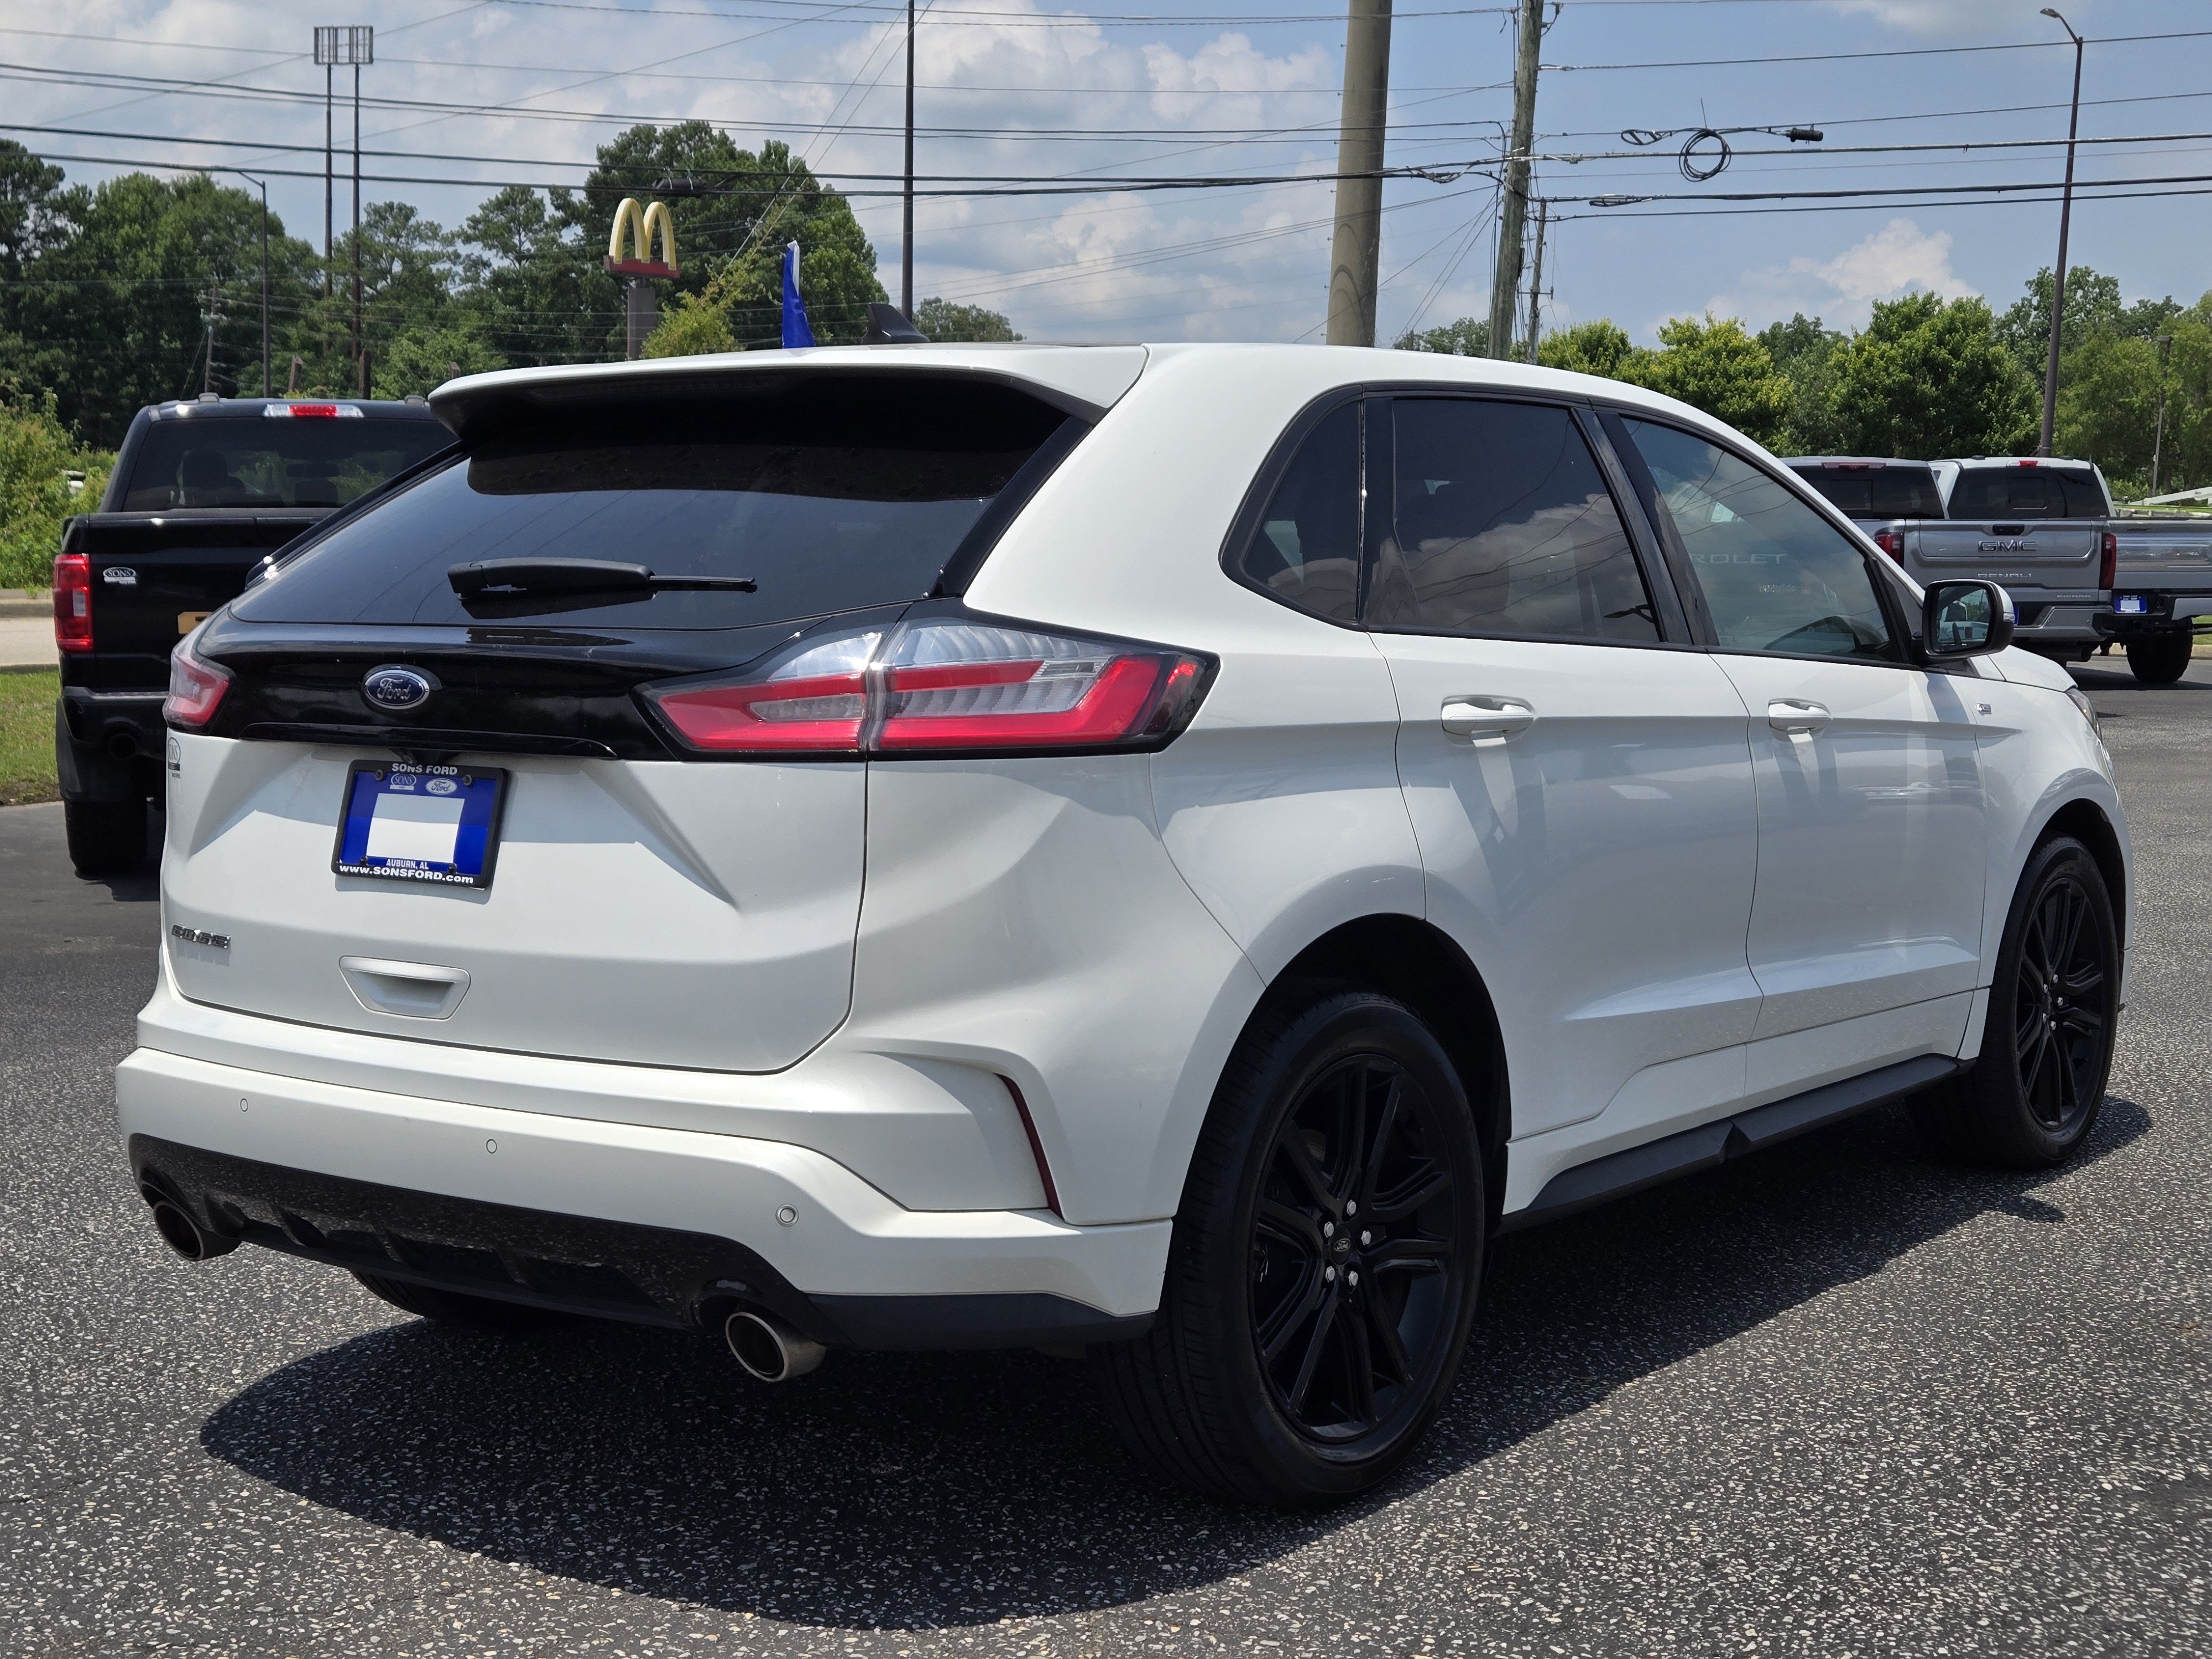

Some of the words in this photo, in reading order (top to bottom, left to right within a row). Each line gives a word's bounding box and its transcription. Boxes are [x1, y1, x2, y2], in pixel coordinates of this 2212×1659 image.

[1978, 539, 2037, 552] GMC
[377, 677, 411, 700] Ford
[392, 763, 422, 773] SONS
[426, 765, 458, 775] FORD
[394, 775, 413, 785] SONS
[431, 780, 451, 792] Ford
[386, 859, 418, 870] AUBURN,
[419, 861, 429, 870] AL
[339, 865, 473, 884] www.SONSFORD.com
[171, 924, 231, 948] EDGE
[1337, 1240, 1349, 1250] Ford
